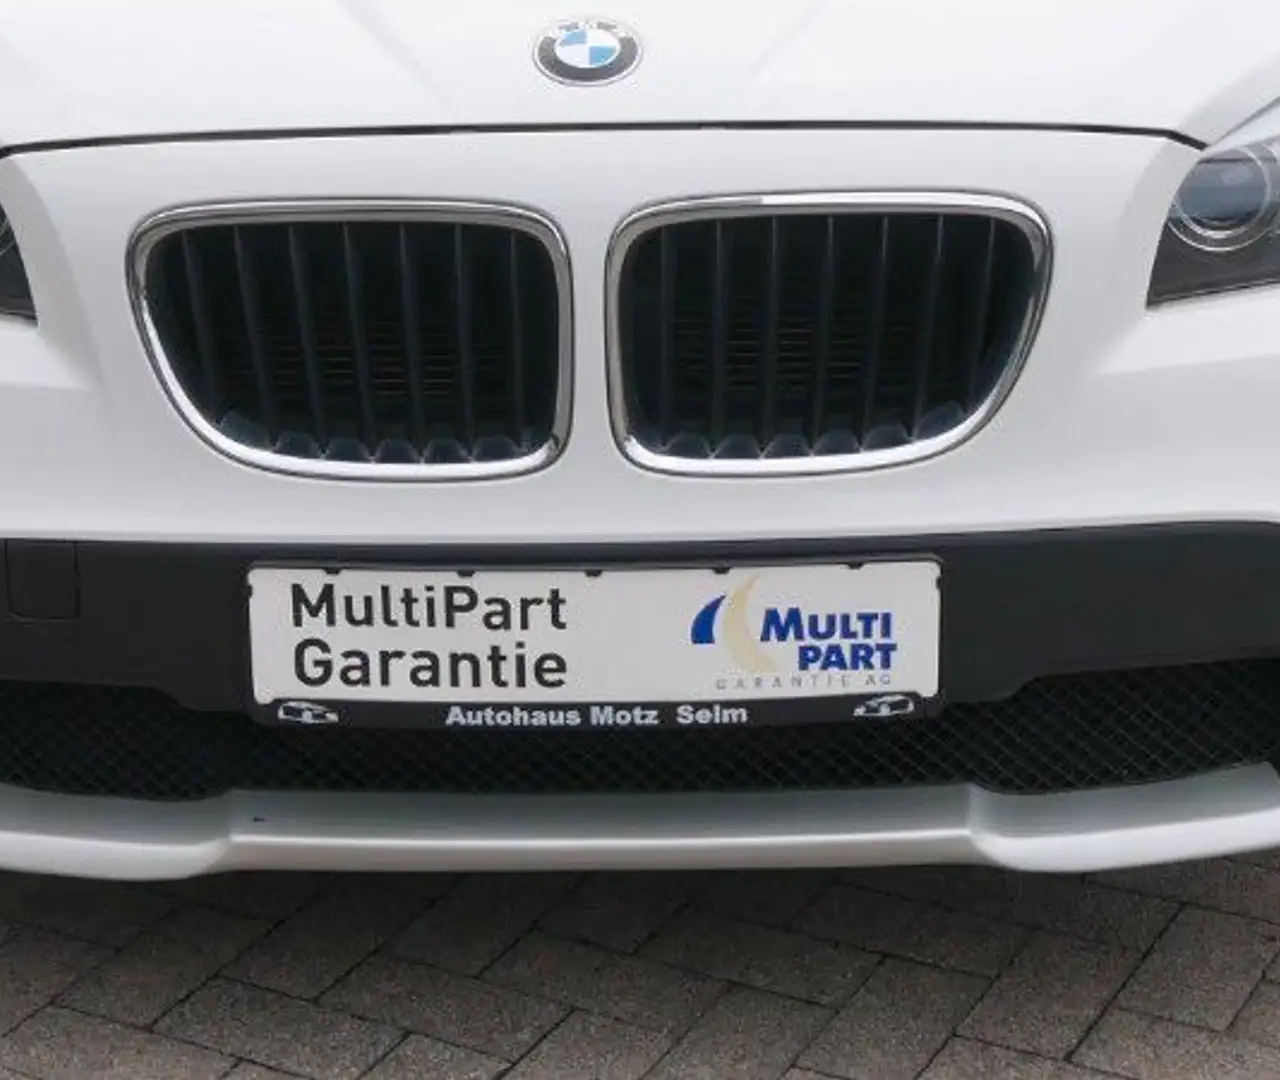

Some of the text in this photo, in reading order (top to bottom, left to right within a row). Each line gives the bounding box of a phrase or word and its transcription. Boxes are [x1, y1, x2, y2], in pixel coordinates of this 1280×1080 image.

[290, 582, 568, 631] MultiPart
[759, 606, 893, 643] MULTI
[293, 636, 568, 689] Garantie
[797, 642, 898, 671] PART
[715, 673, 892, 690] GARANTIE AG
[444, 703, 748, 727] Autohaus Motz Selm
